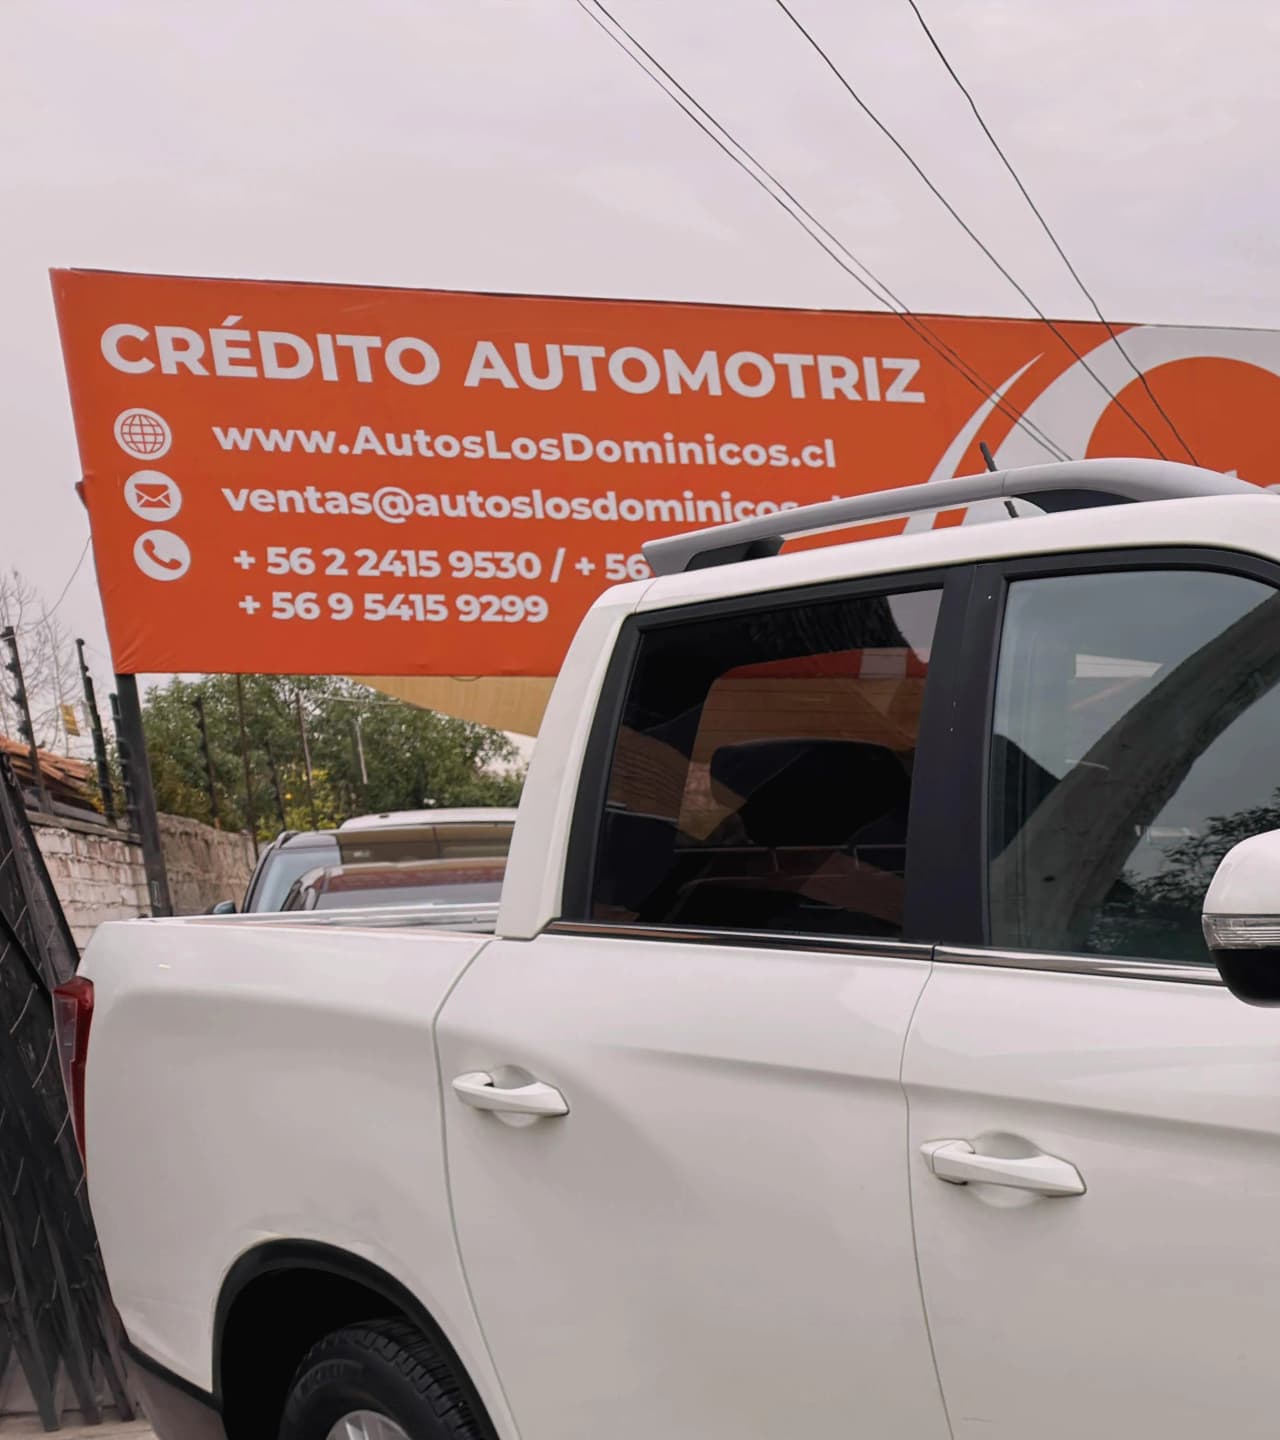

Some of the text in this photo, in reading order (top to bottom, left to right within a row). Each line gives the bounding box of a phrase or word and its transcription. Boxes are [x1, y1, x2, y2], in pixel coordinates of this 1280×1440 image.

[100, 315, 926, 404] CRÉDITO AUTOMOTRIZ
[212, 425, 836, 468] www.AutosLosDominicos.cl
[267, 546, 316, 576] 56
[321, 547, 349, 576] 2
[354, 548, 442, 578] 2415
[448, 550, 542, 580] 9530
[271, 591, 321, 620] 56
[327, 592, 354, 621] 9
[363, 593, 449, 622] 5415
[455, 594, 549, 623] 9299
